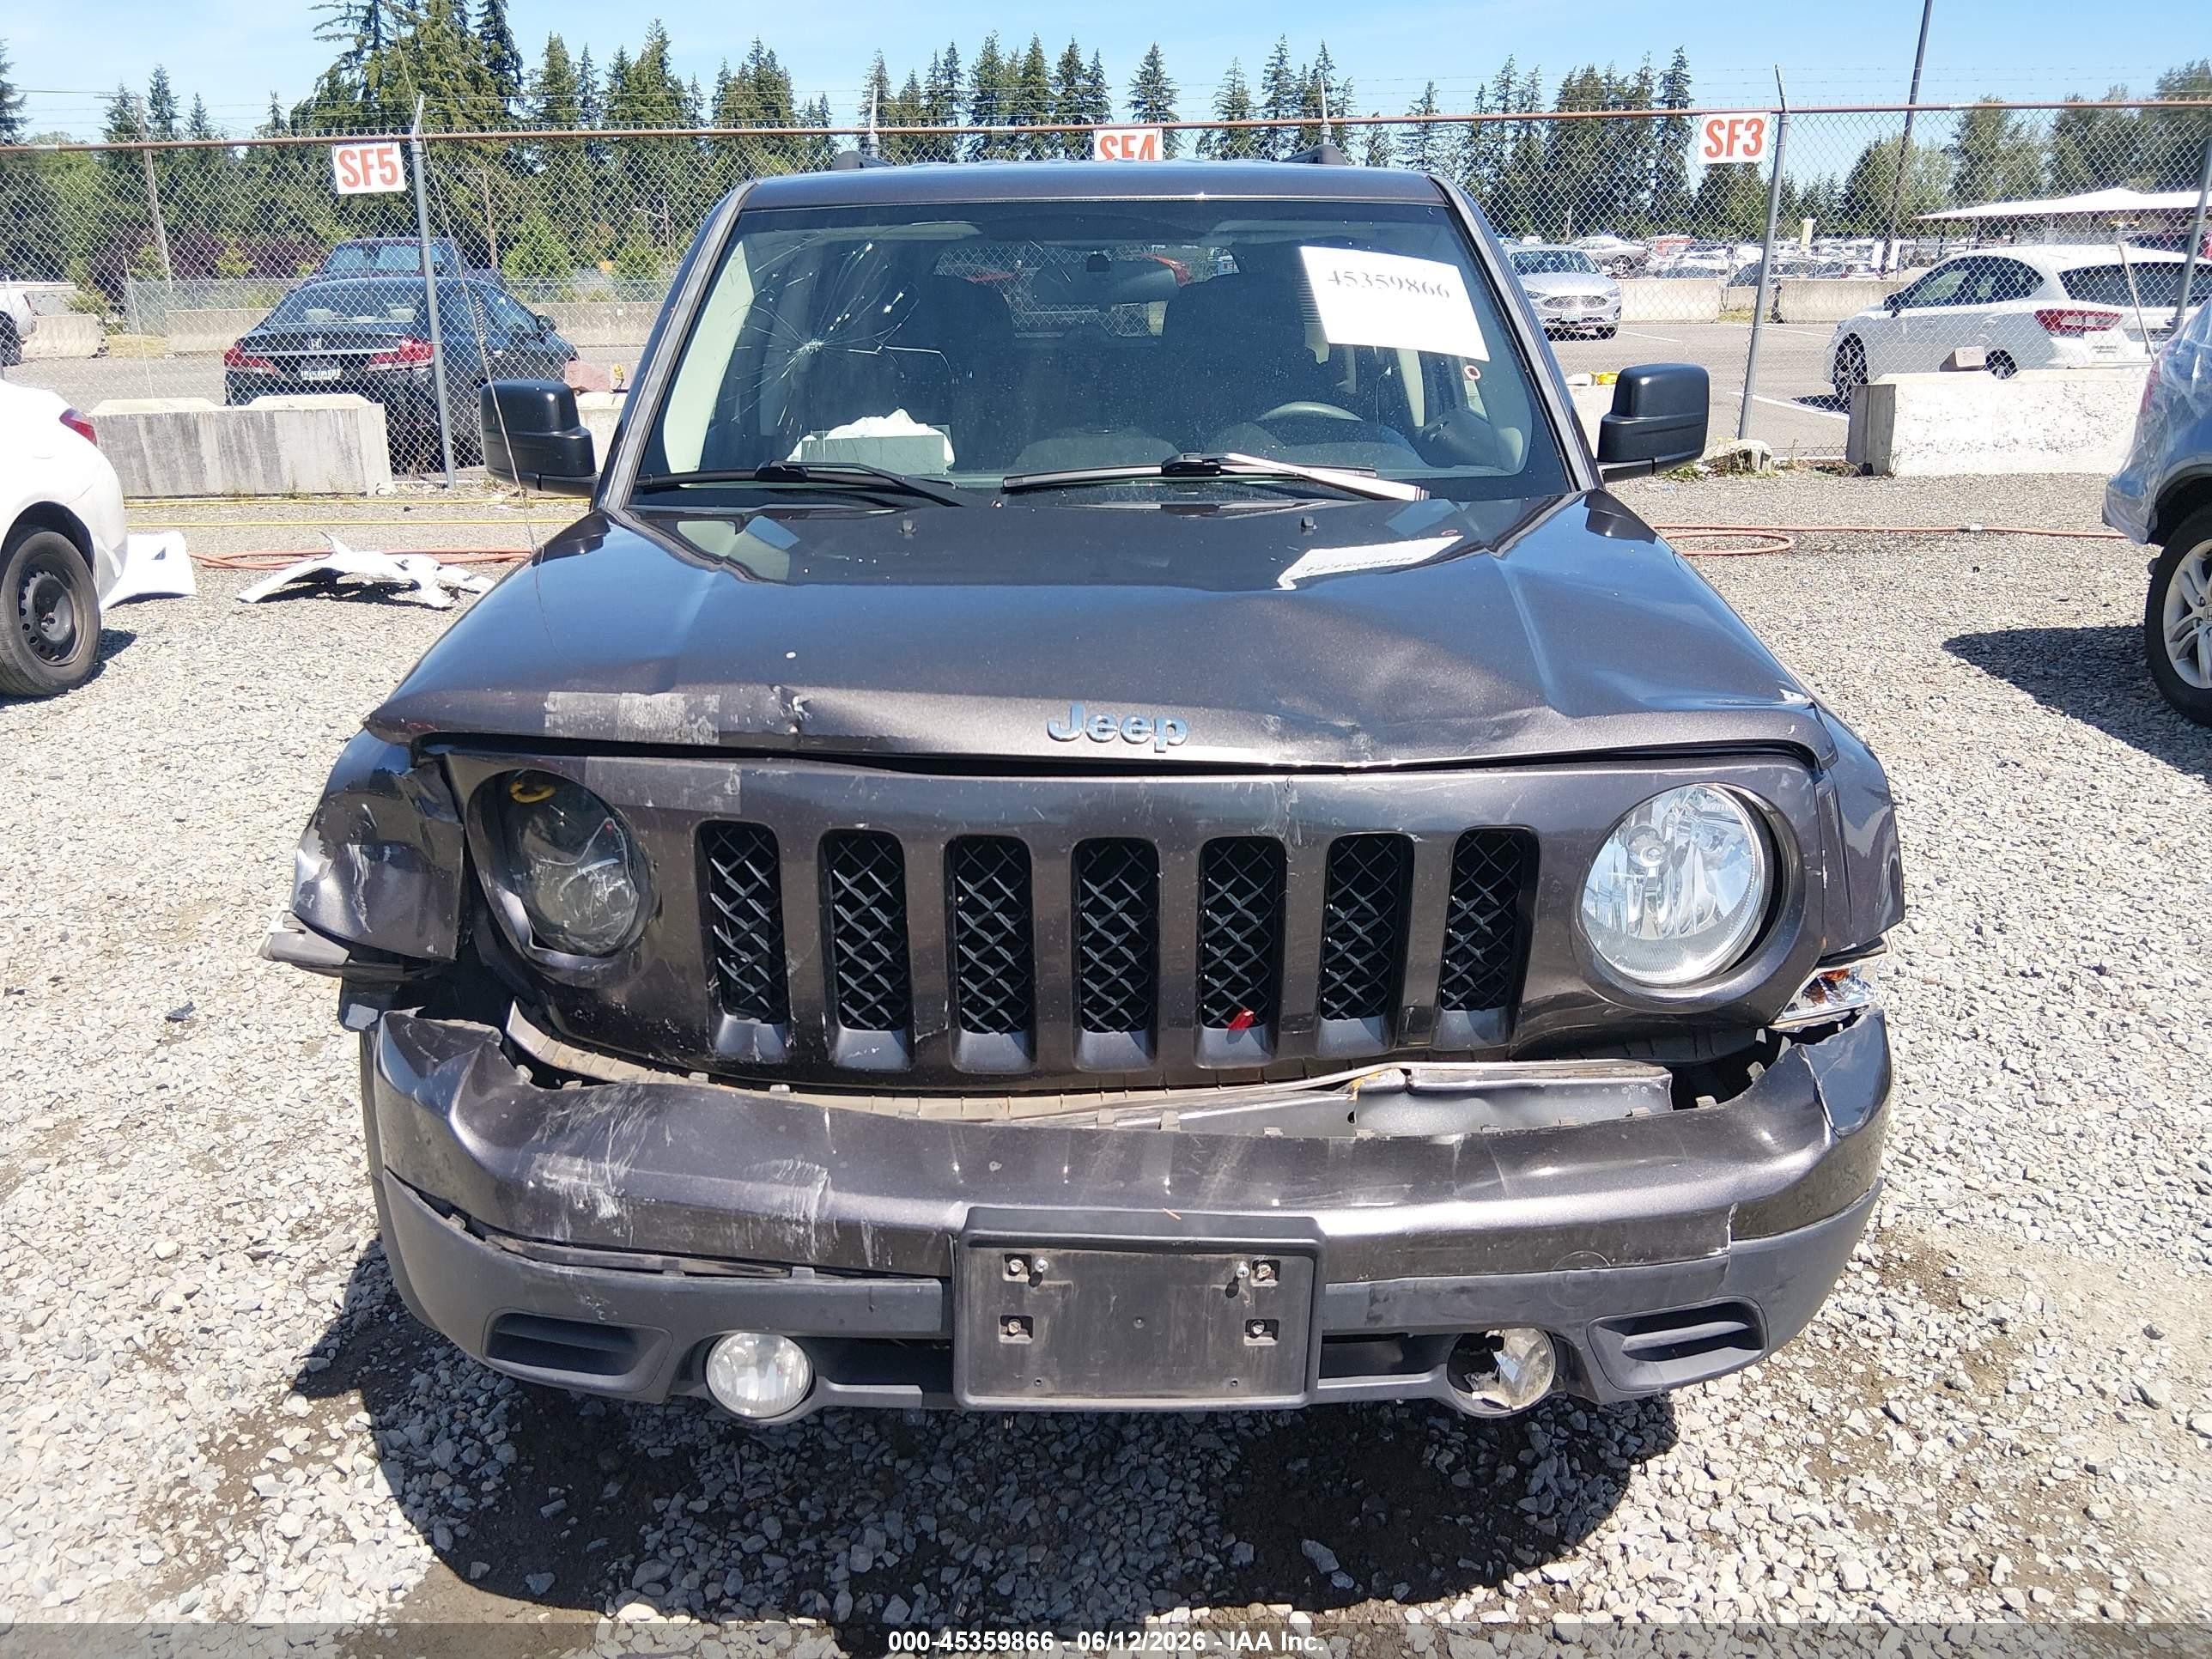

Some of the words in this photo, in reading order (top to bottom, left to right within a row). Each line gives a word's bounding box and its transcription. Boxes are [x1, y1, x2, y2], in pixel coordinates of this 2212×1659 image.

[1704, 118, 1765, 158] SF3
[338, 148, 398, 187] SF5
[1047, 702, 1188, 754] Jeep
